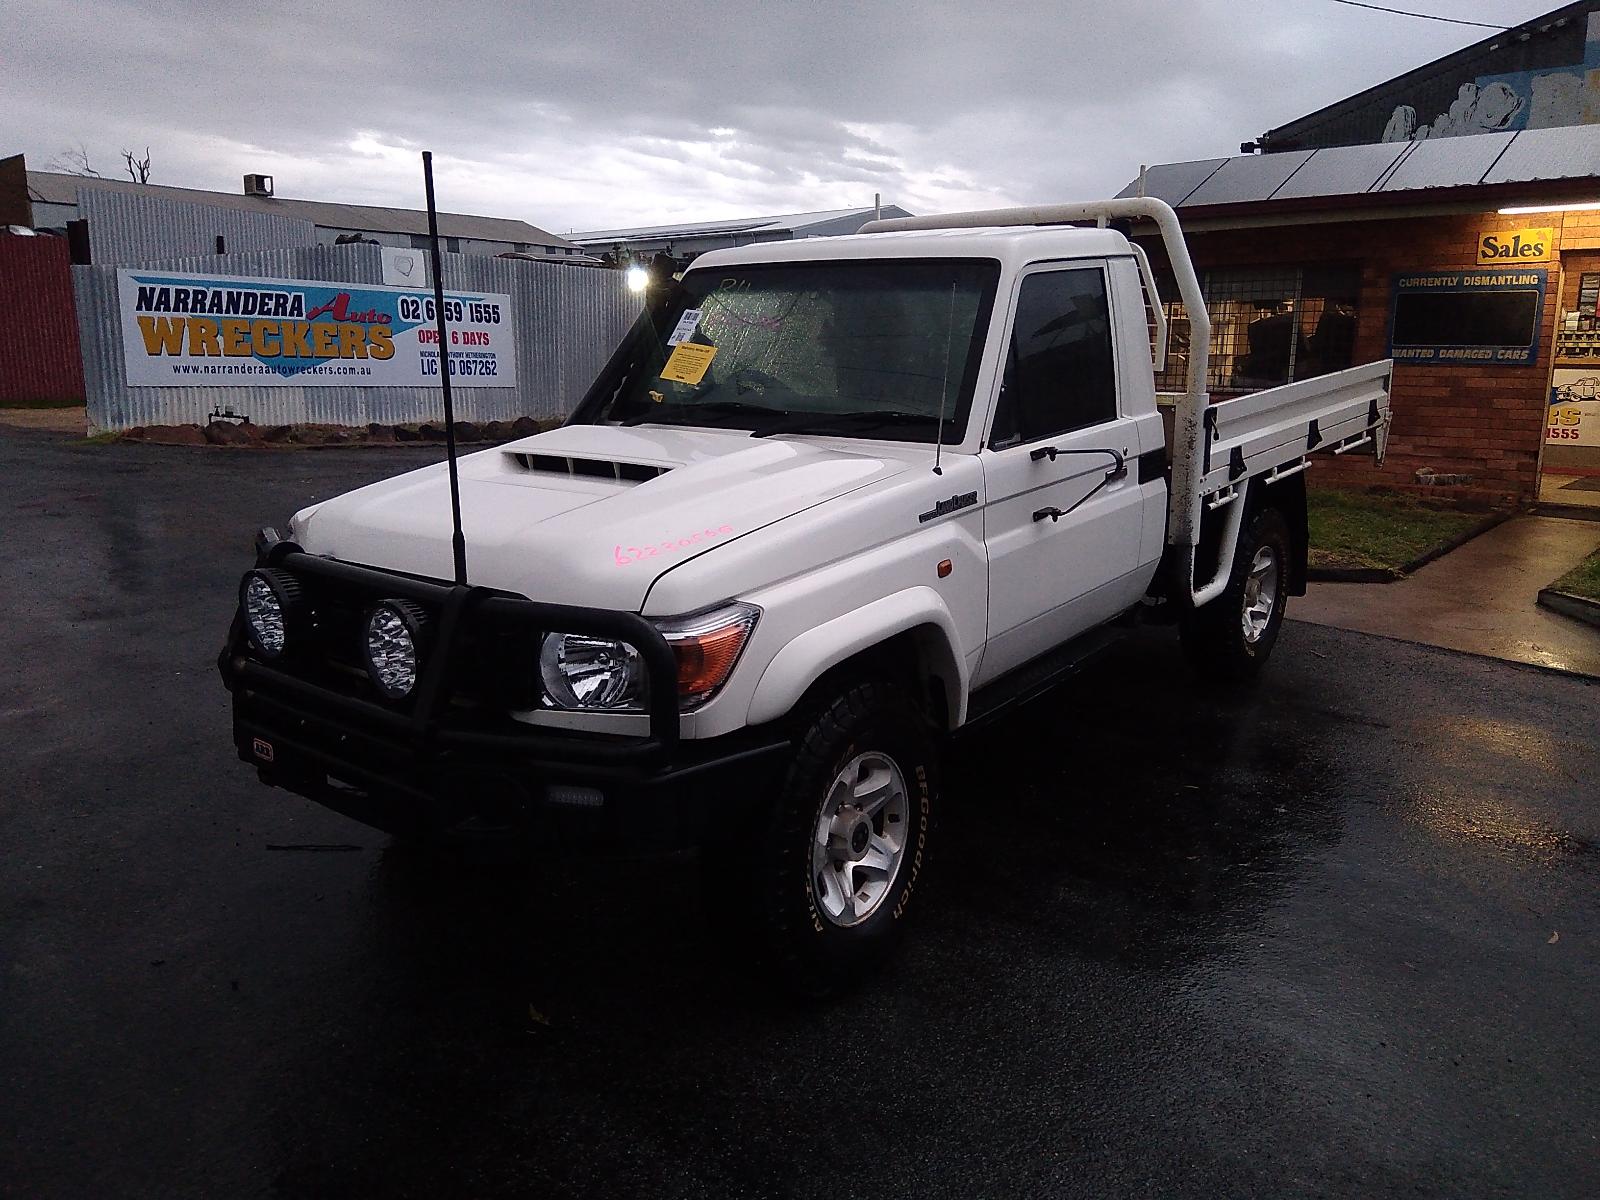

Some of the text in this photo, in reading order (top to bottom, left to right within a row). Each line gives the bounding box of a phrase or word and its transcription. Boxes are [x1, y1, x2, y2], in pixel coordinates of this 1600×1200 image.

[1481, 234, 1544, 259] Sales
[1399, 274, 1539, 288] CURRENTLY DISMANTLING
[136, 286, 393, 325] NARRANDERA Auto
[400, 298, 501, 325] 02 659 1555
[136, 315, 396, 361] WRECKERS
[418, 329, 490, 346] OPE 6 DAYS
[1391, 348, 1531, 361] WANTED DAMAGED CARS
[172, 363, 372, 375] www.narranderaautowreckers.com.au
[421, 358, 438, 376] LIC
[459, 359, 498, 376] 067262
